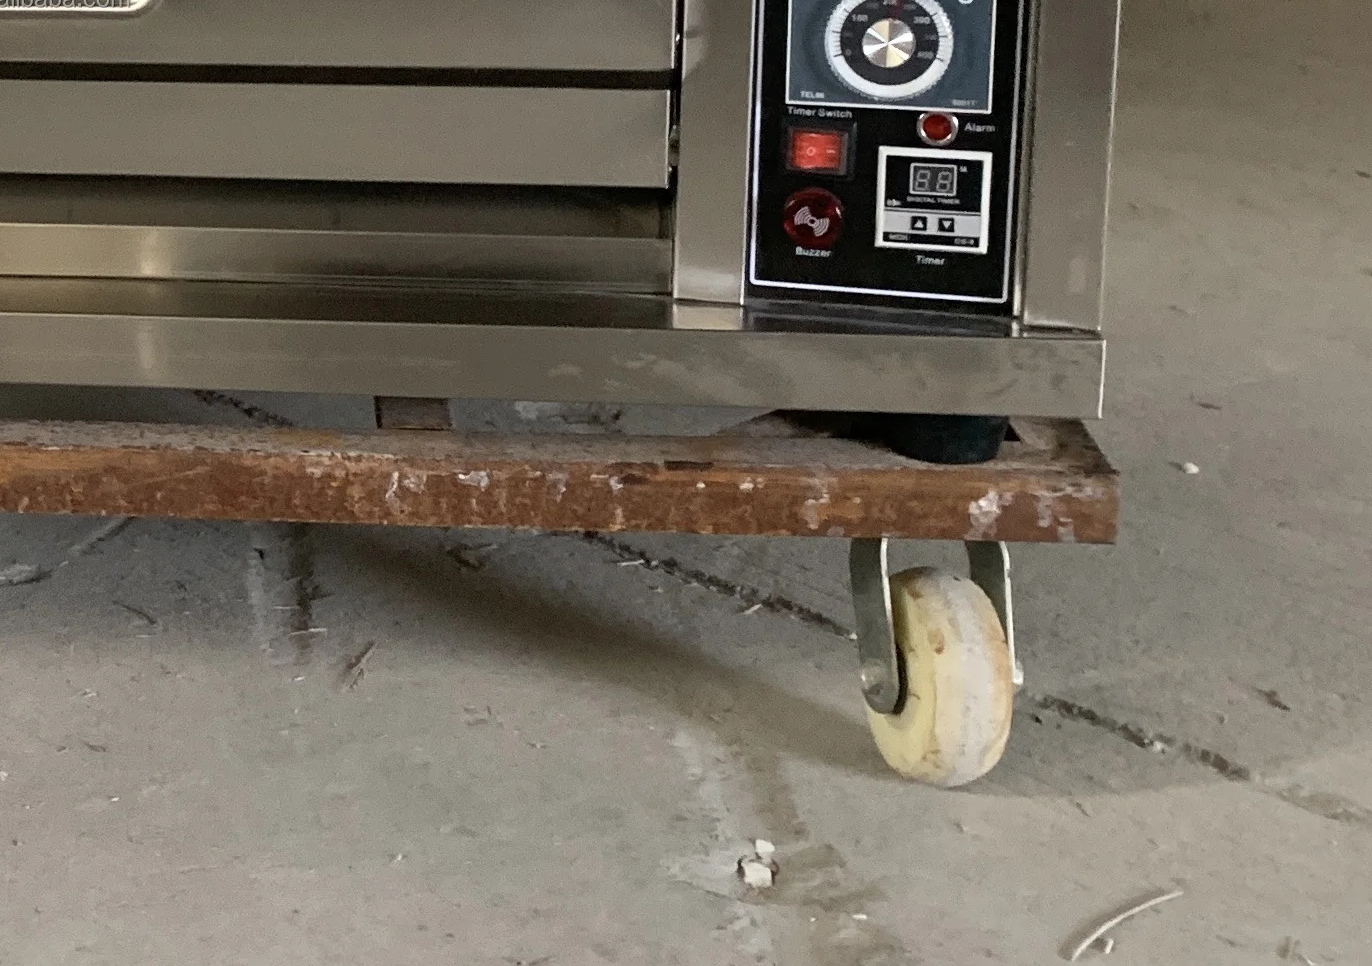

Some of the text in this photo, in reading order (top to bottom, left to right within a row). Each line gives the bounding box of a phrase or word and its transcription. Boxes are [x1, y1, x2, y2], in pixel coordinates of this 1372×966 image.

[787, 106, 852, 119] Timer Switch
[964, 123, 996, 132] Alarm
[795, 247, 832, 257] Buzzer
[915, 254, 945, 265] Timer
